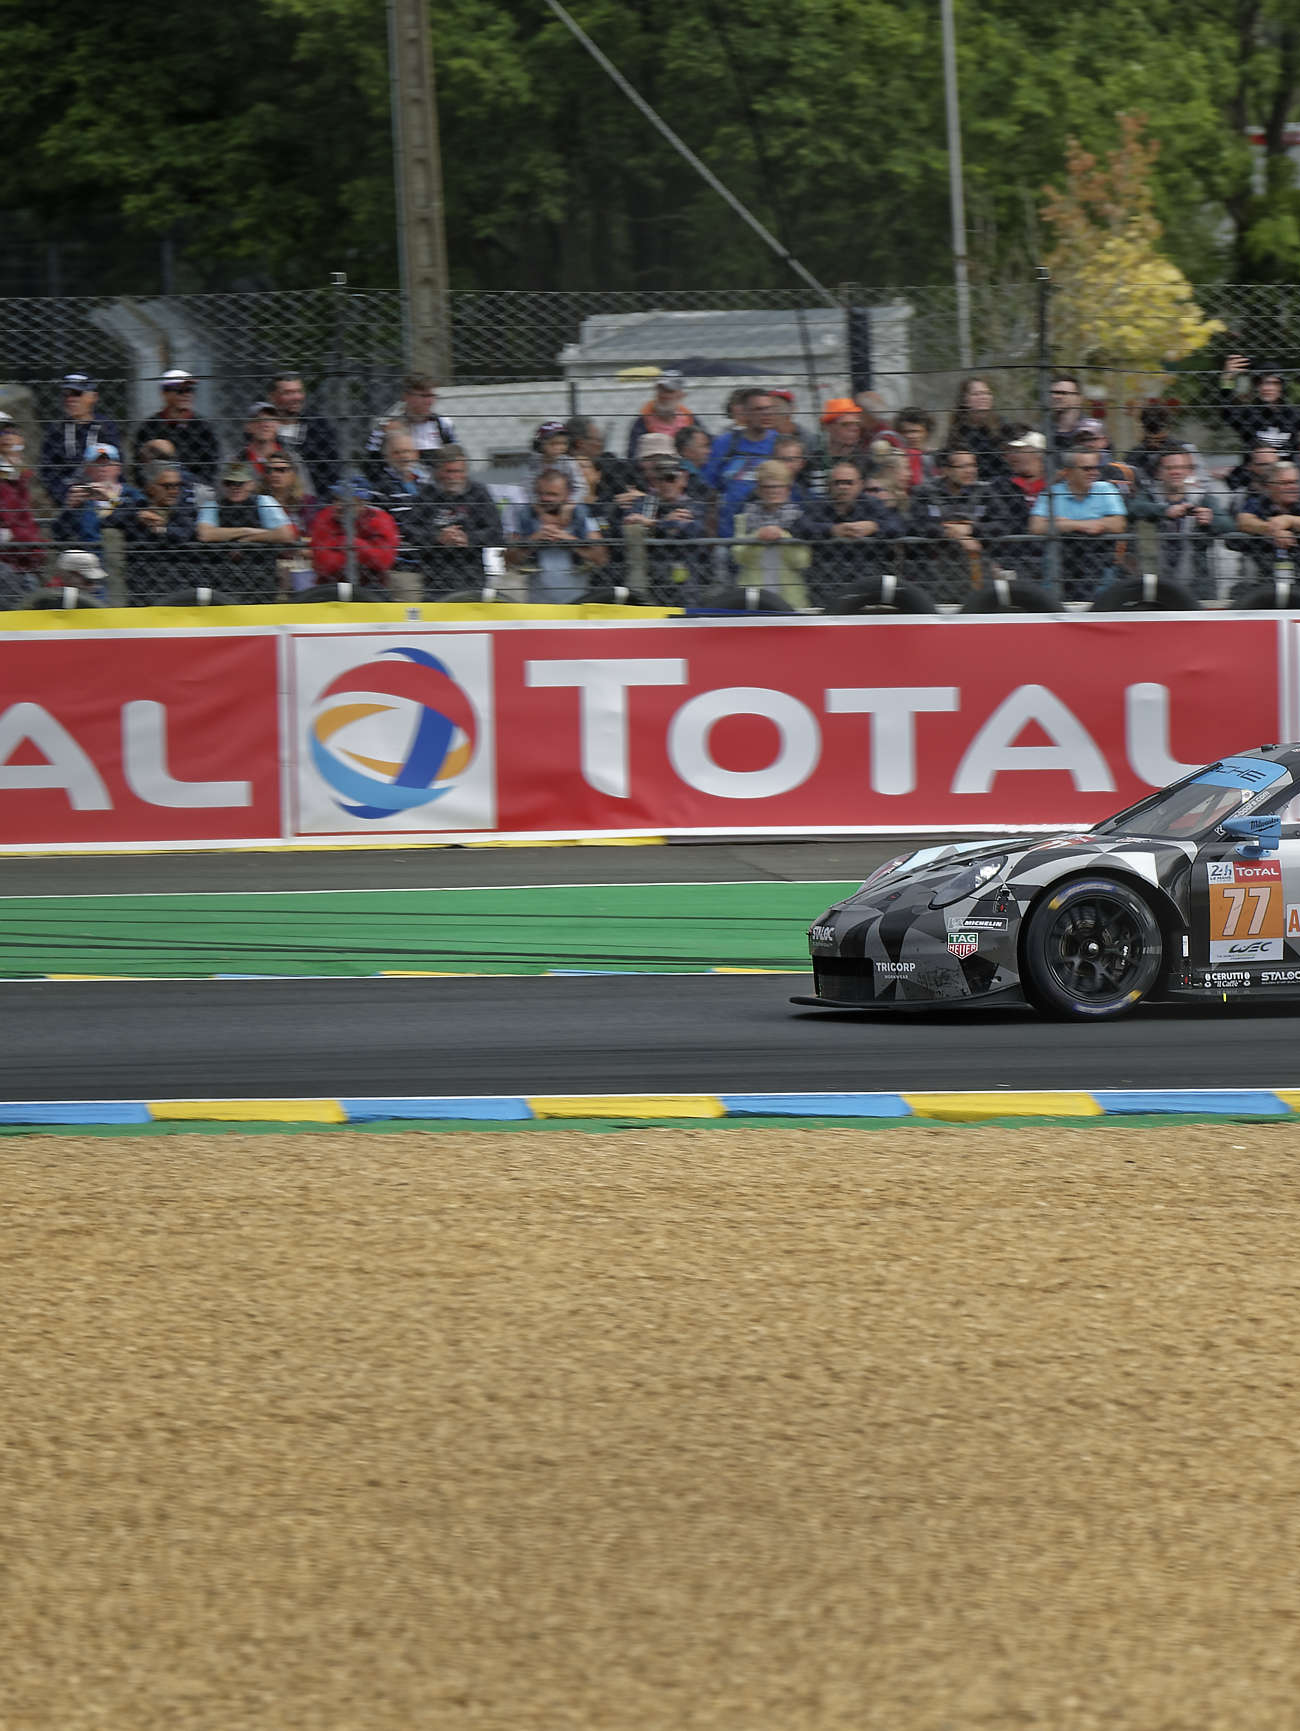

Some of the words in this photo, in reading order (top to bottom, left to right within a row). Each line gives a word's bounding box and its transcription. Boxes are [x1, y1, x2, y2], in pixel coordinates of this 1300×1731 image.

[526, 657, 1207, 799] TOTAL
[1235, 867, 1279, 876] TOTAL
[1222, 887, 1272, 936] 77
[951, 935, 975, 943] TAG
[950, 944, 977, 957] HEUER
[876, 962, 916, 972] TRICORP
